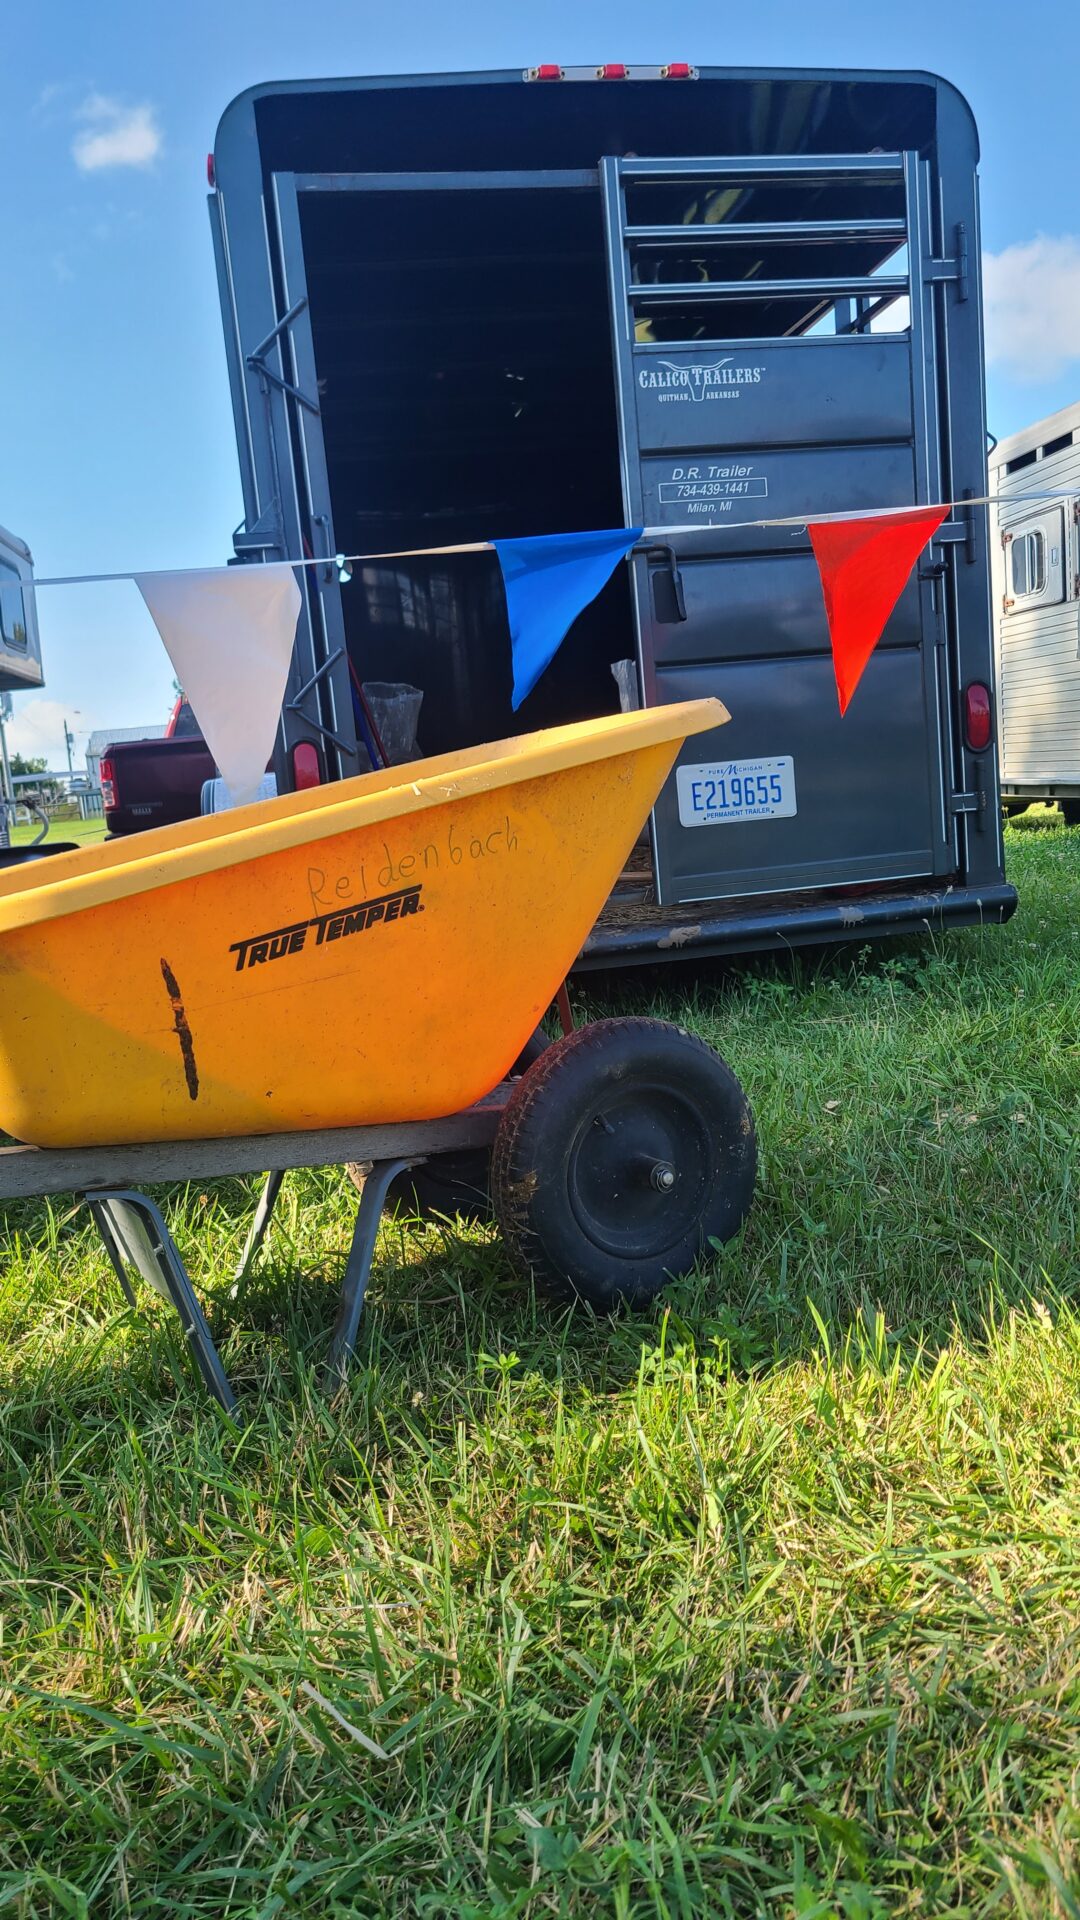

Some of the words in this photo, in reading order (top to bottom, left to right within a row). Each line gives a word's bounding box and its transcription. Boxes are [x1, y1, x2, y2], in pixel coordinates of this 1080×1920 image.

[639, 370, 689, 388] CALICO
[658, 393, 692, 402] QUITMAN,
[706, 390, 740, 400] ARKANSAS
[672, 468, 701, 480] D.R.
[708, 465, 753, 478] Trailer
[677, 482, 749, 497] 734-439-1441
[687, 502, 717, 514] Milan,
[719, 501, 732, 512] MI
[722, 764, 763, 778] MICHIGAN
[691, 774, 782, 811] E219655
[706, 809, 743, 819] PERMANENT
[745, 807, 770, 815] TRAILER
[307, 816, 518, 918] Reidenbach
[229, 921, 309, 971] TRUE
[308, 884, 423, 945] TEMPER
